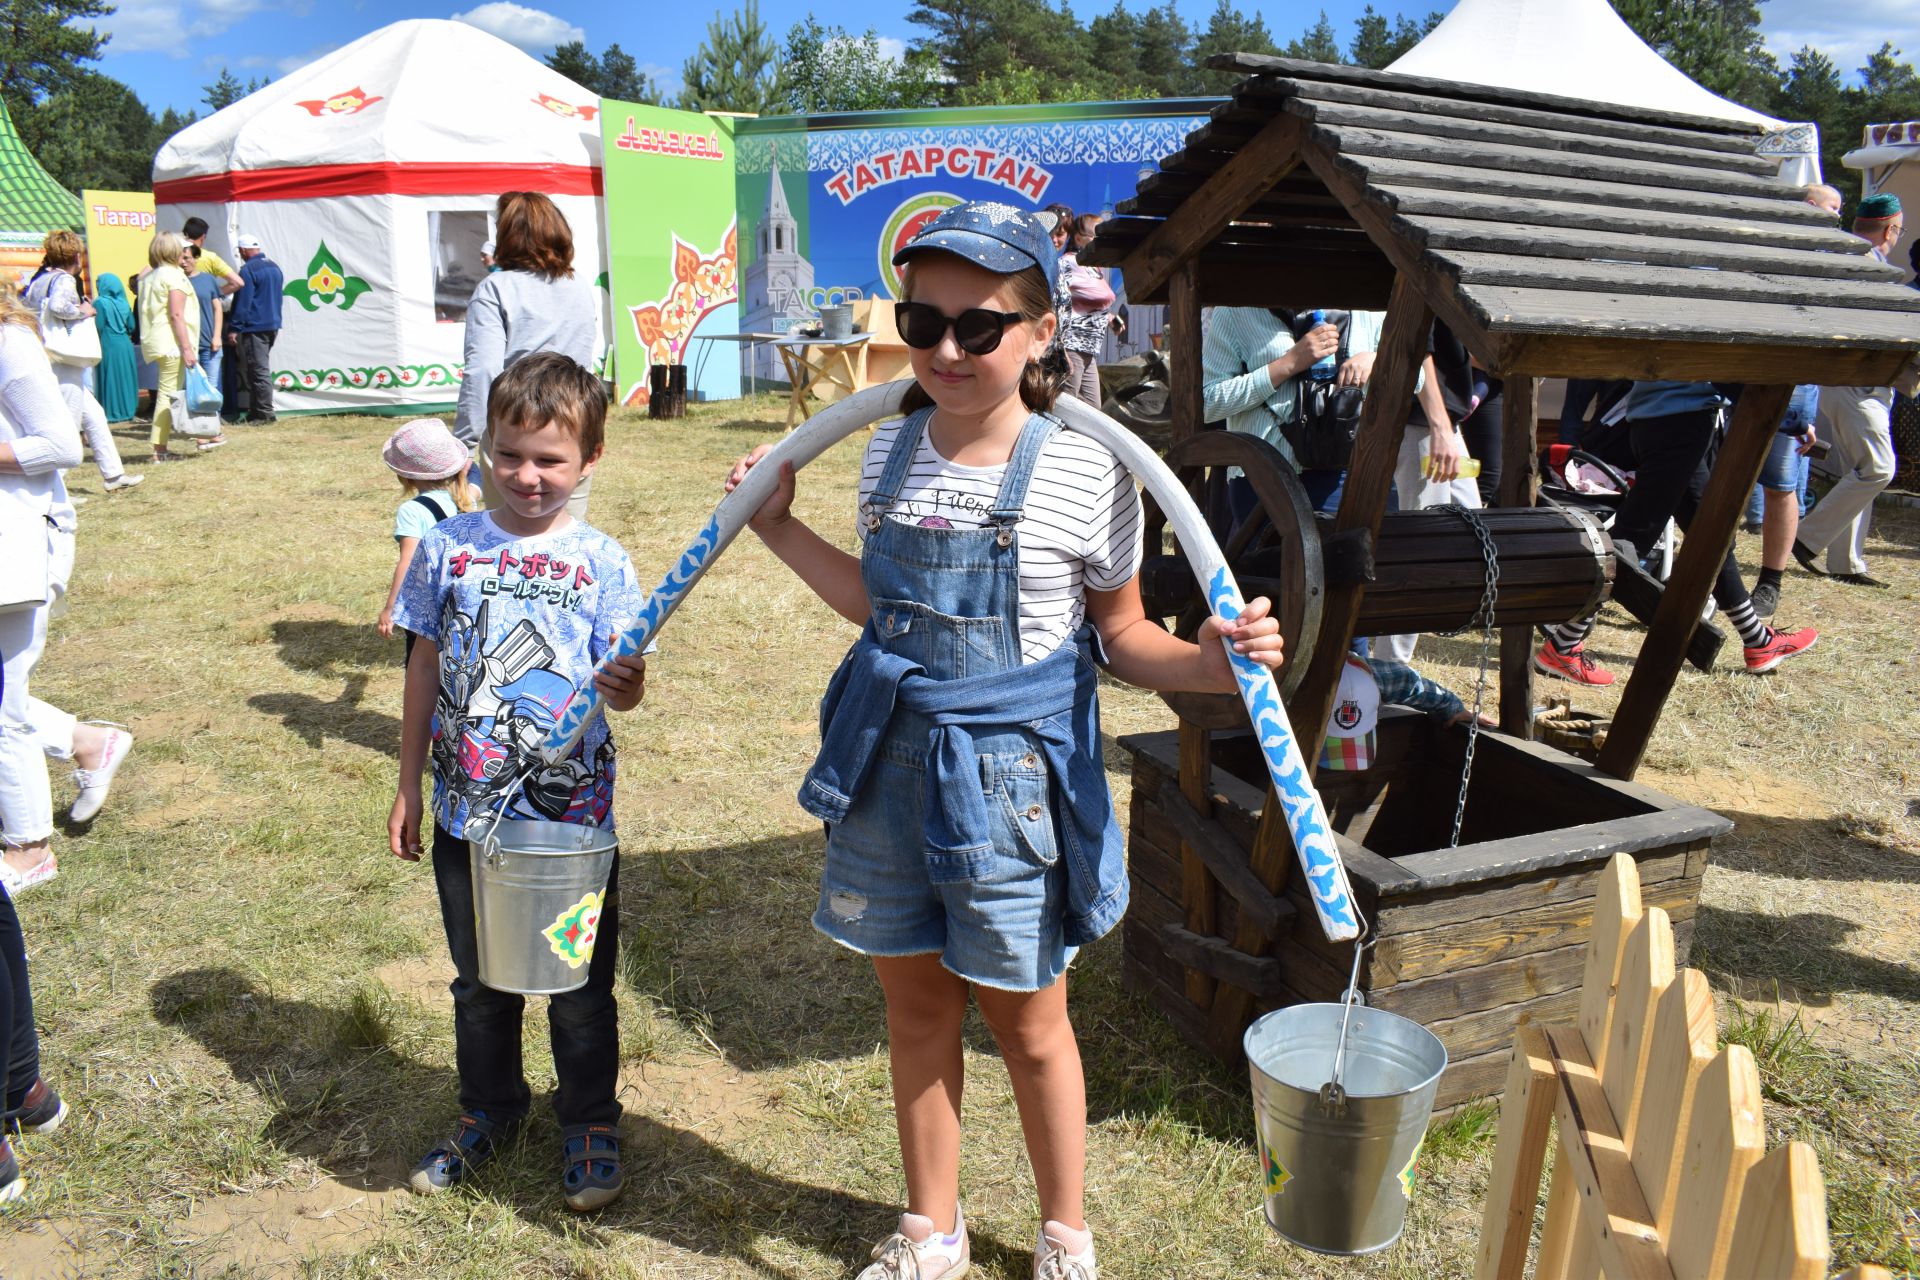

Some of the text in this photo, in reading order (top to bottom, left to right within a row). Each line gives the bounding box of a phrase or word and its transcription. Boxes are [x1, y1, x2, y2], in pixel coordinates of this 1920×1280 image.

[616, 117, 724, 160] Азнакай
[826, 146, 1051, 203] ТАТАРСТАН
[449, 548, 594, 590] オートボット
[481, 577, 585, 612] ロールアウト!
